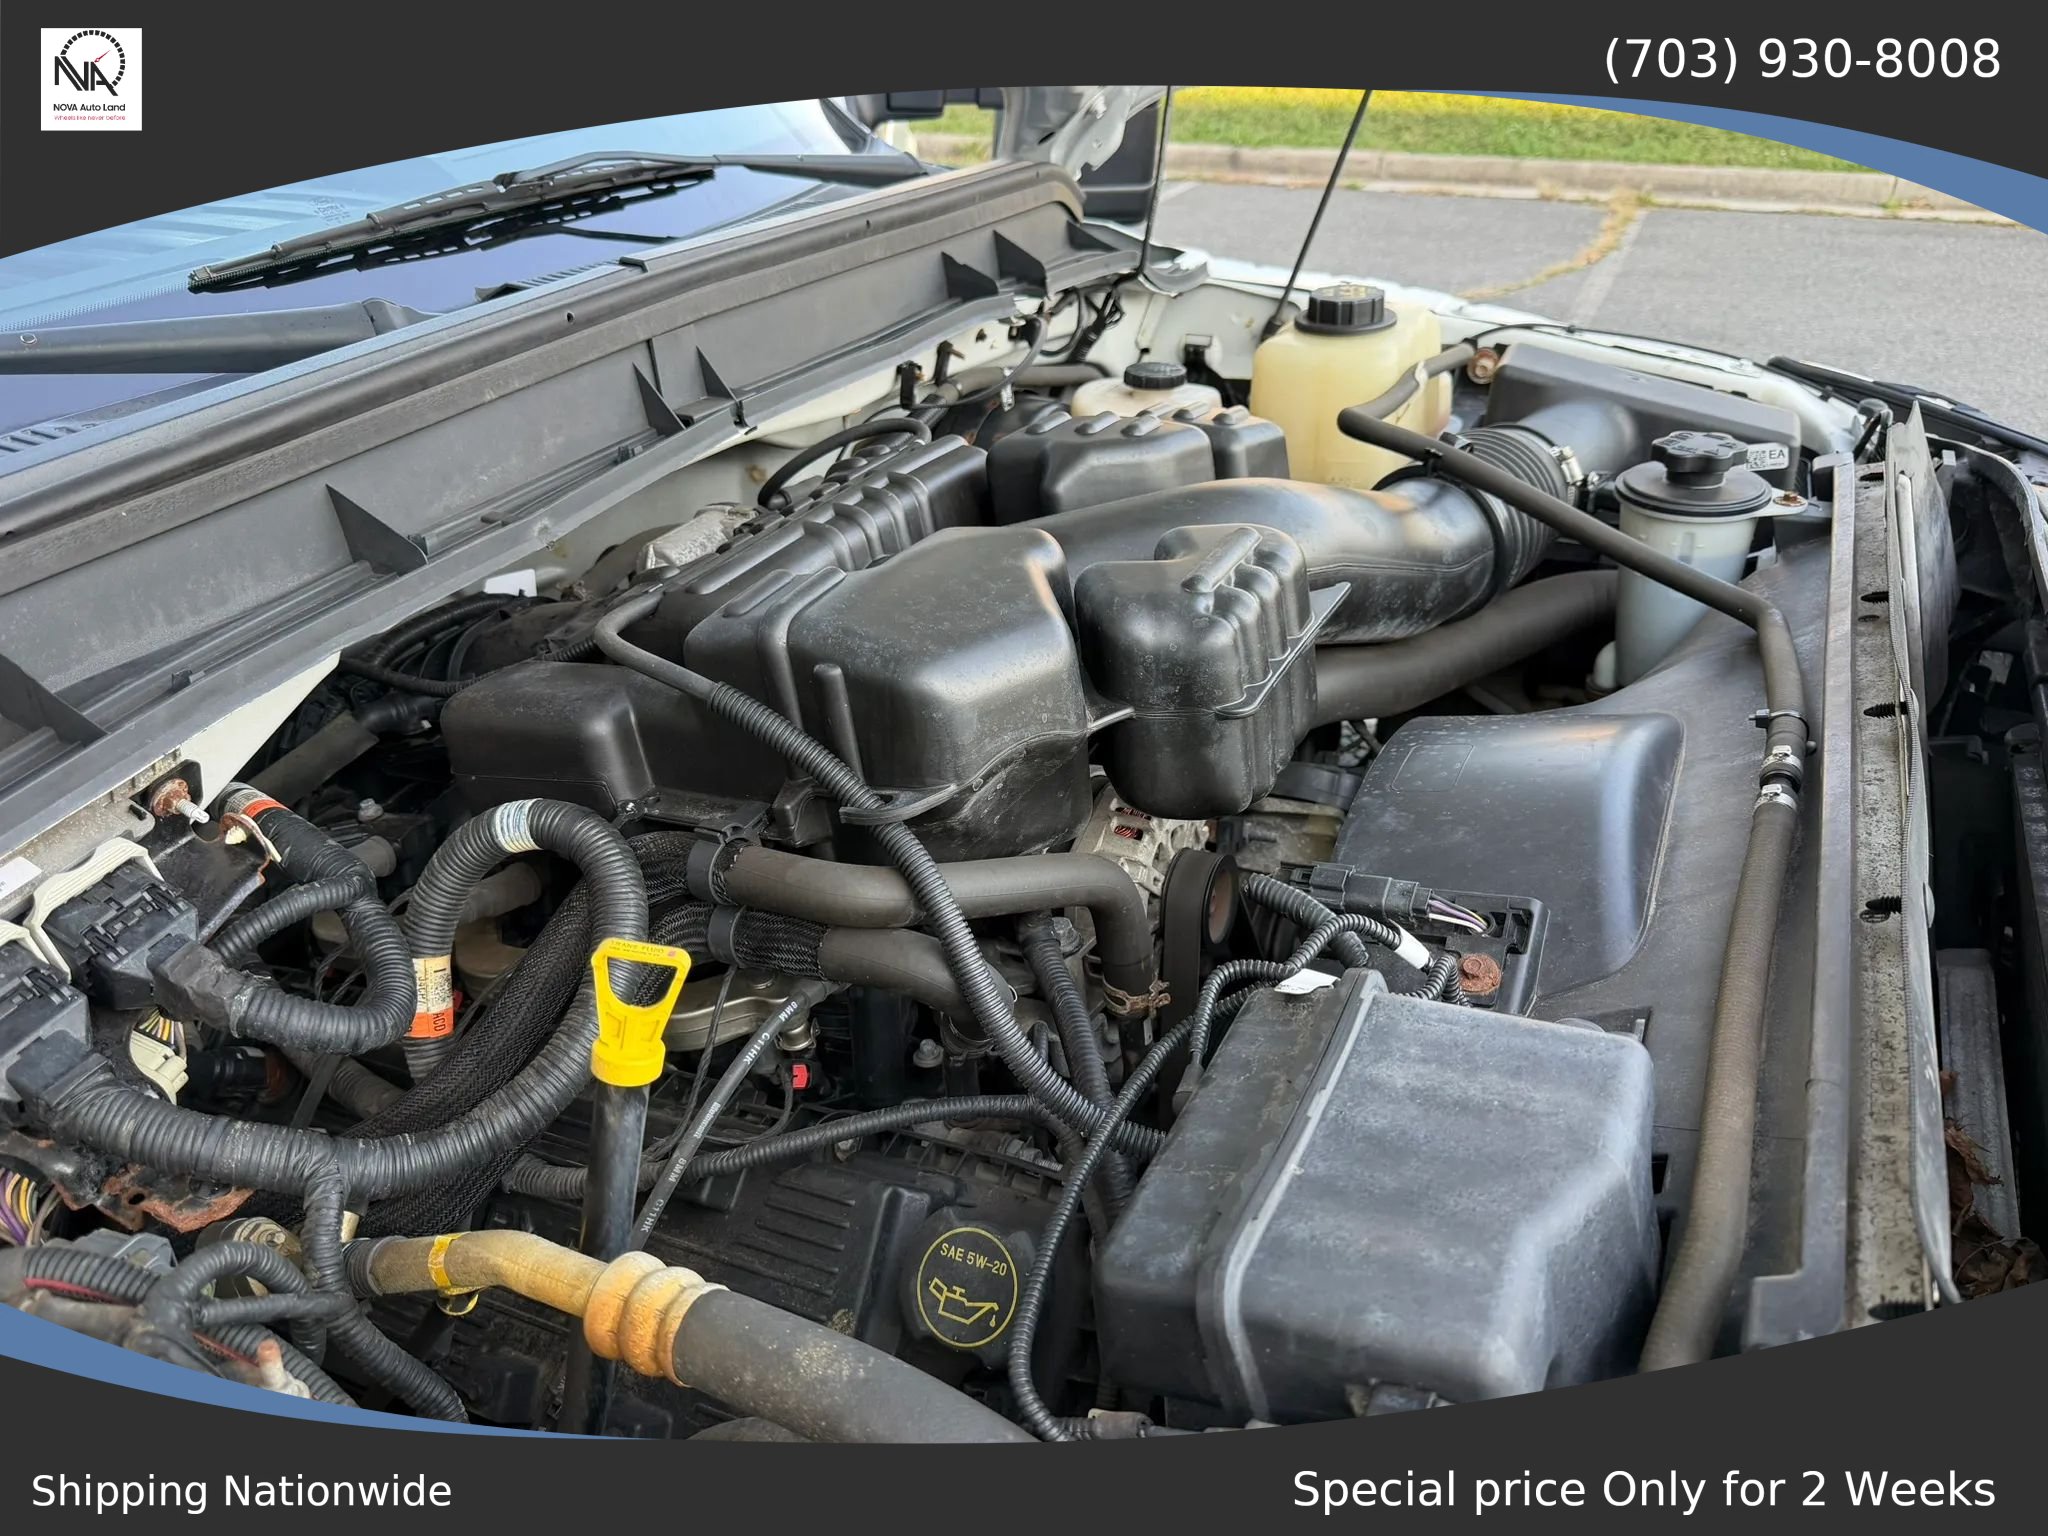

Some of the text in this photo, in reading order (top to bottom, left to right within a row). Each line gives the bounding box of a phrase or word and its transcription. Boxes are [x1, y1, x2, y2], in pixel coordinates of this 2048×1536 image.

[1769, 449, 1785, 460] EA
[432, 1012, 446, 1032] ACD
[667, 1157, 687, 1183] 8MM
[940, 1243, 1008, 1276] SAE 5W-20
